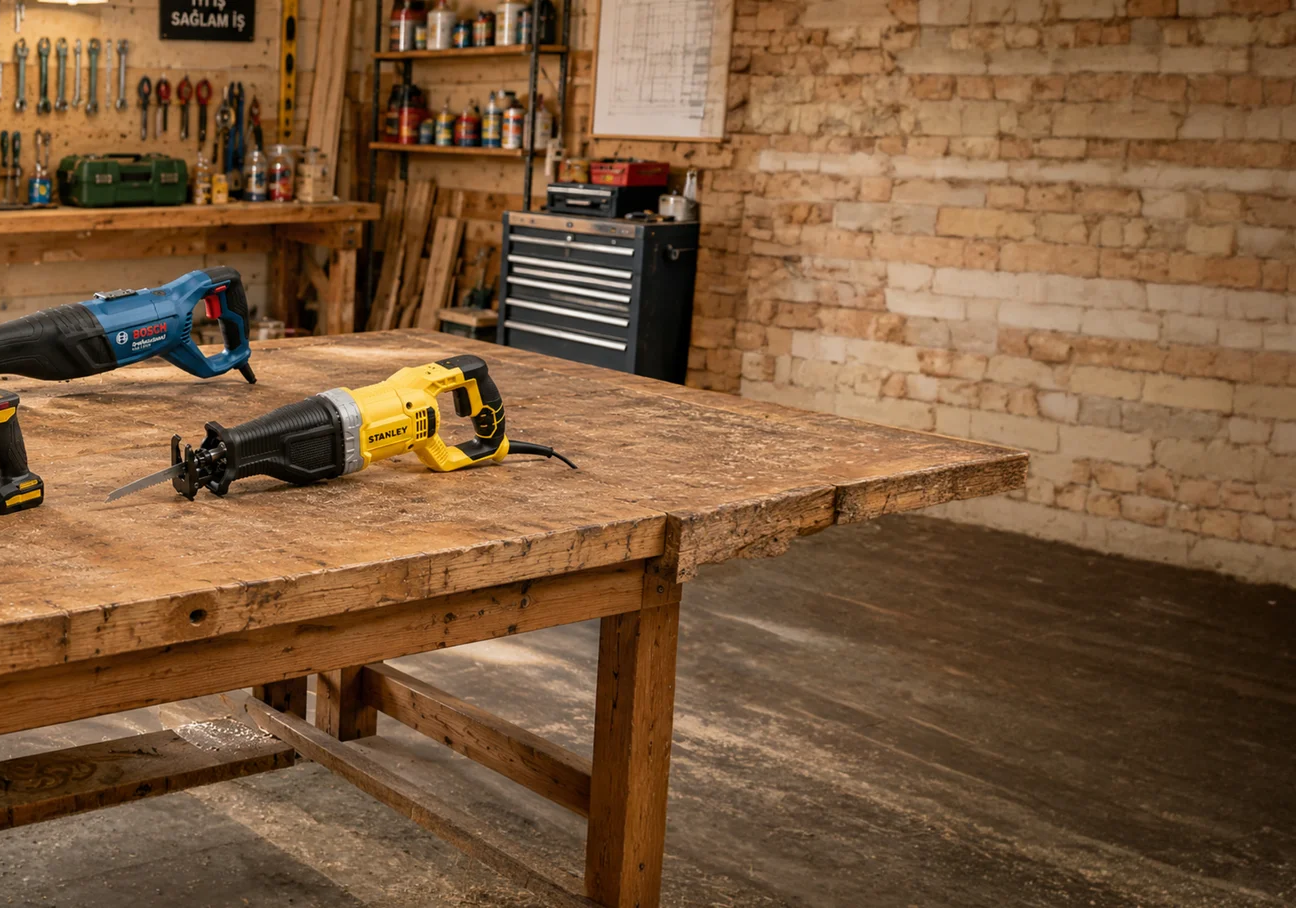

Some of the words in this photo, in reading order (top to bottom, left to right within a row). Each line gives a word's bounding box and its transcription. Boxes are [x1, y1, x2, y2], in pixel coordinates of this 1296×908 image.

[171, 8, 229, 28] SAĞLAM
[232, 10, 246, 32] İŞ
[132, 322, 167, 340] BOSCH
[368, 425, 408, 444] STANLEY
